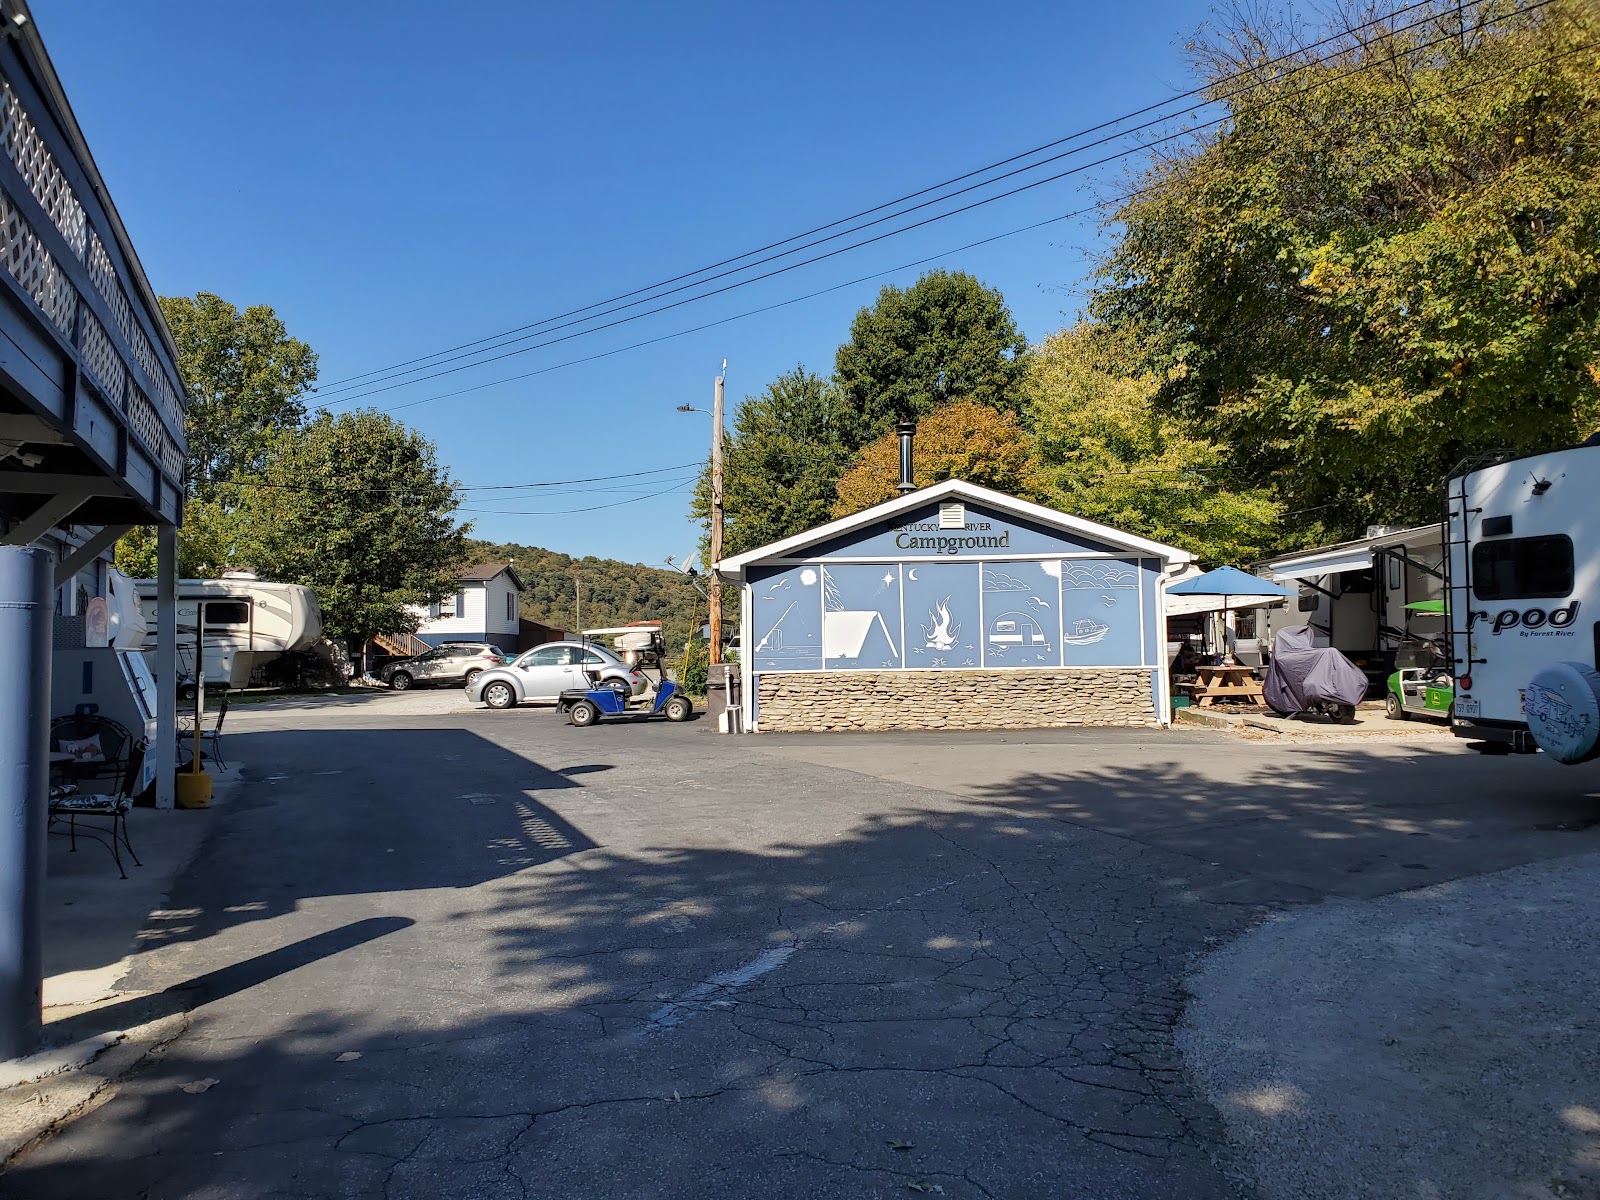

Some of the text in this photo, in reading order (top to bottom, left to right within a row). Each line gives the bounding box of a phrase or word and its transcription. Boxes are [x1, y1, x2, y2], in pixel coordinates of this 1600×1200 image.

[964, 522, 992, 532] RIVER
[895, 530, 1010, 554] Campground
[177, 608, 202, 617] Cree
[1519, 630, 1529, 638] By
